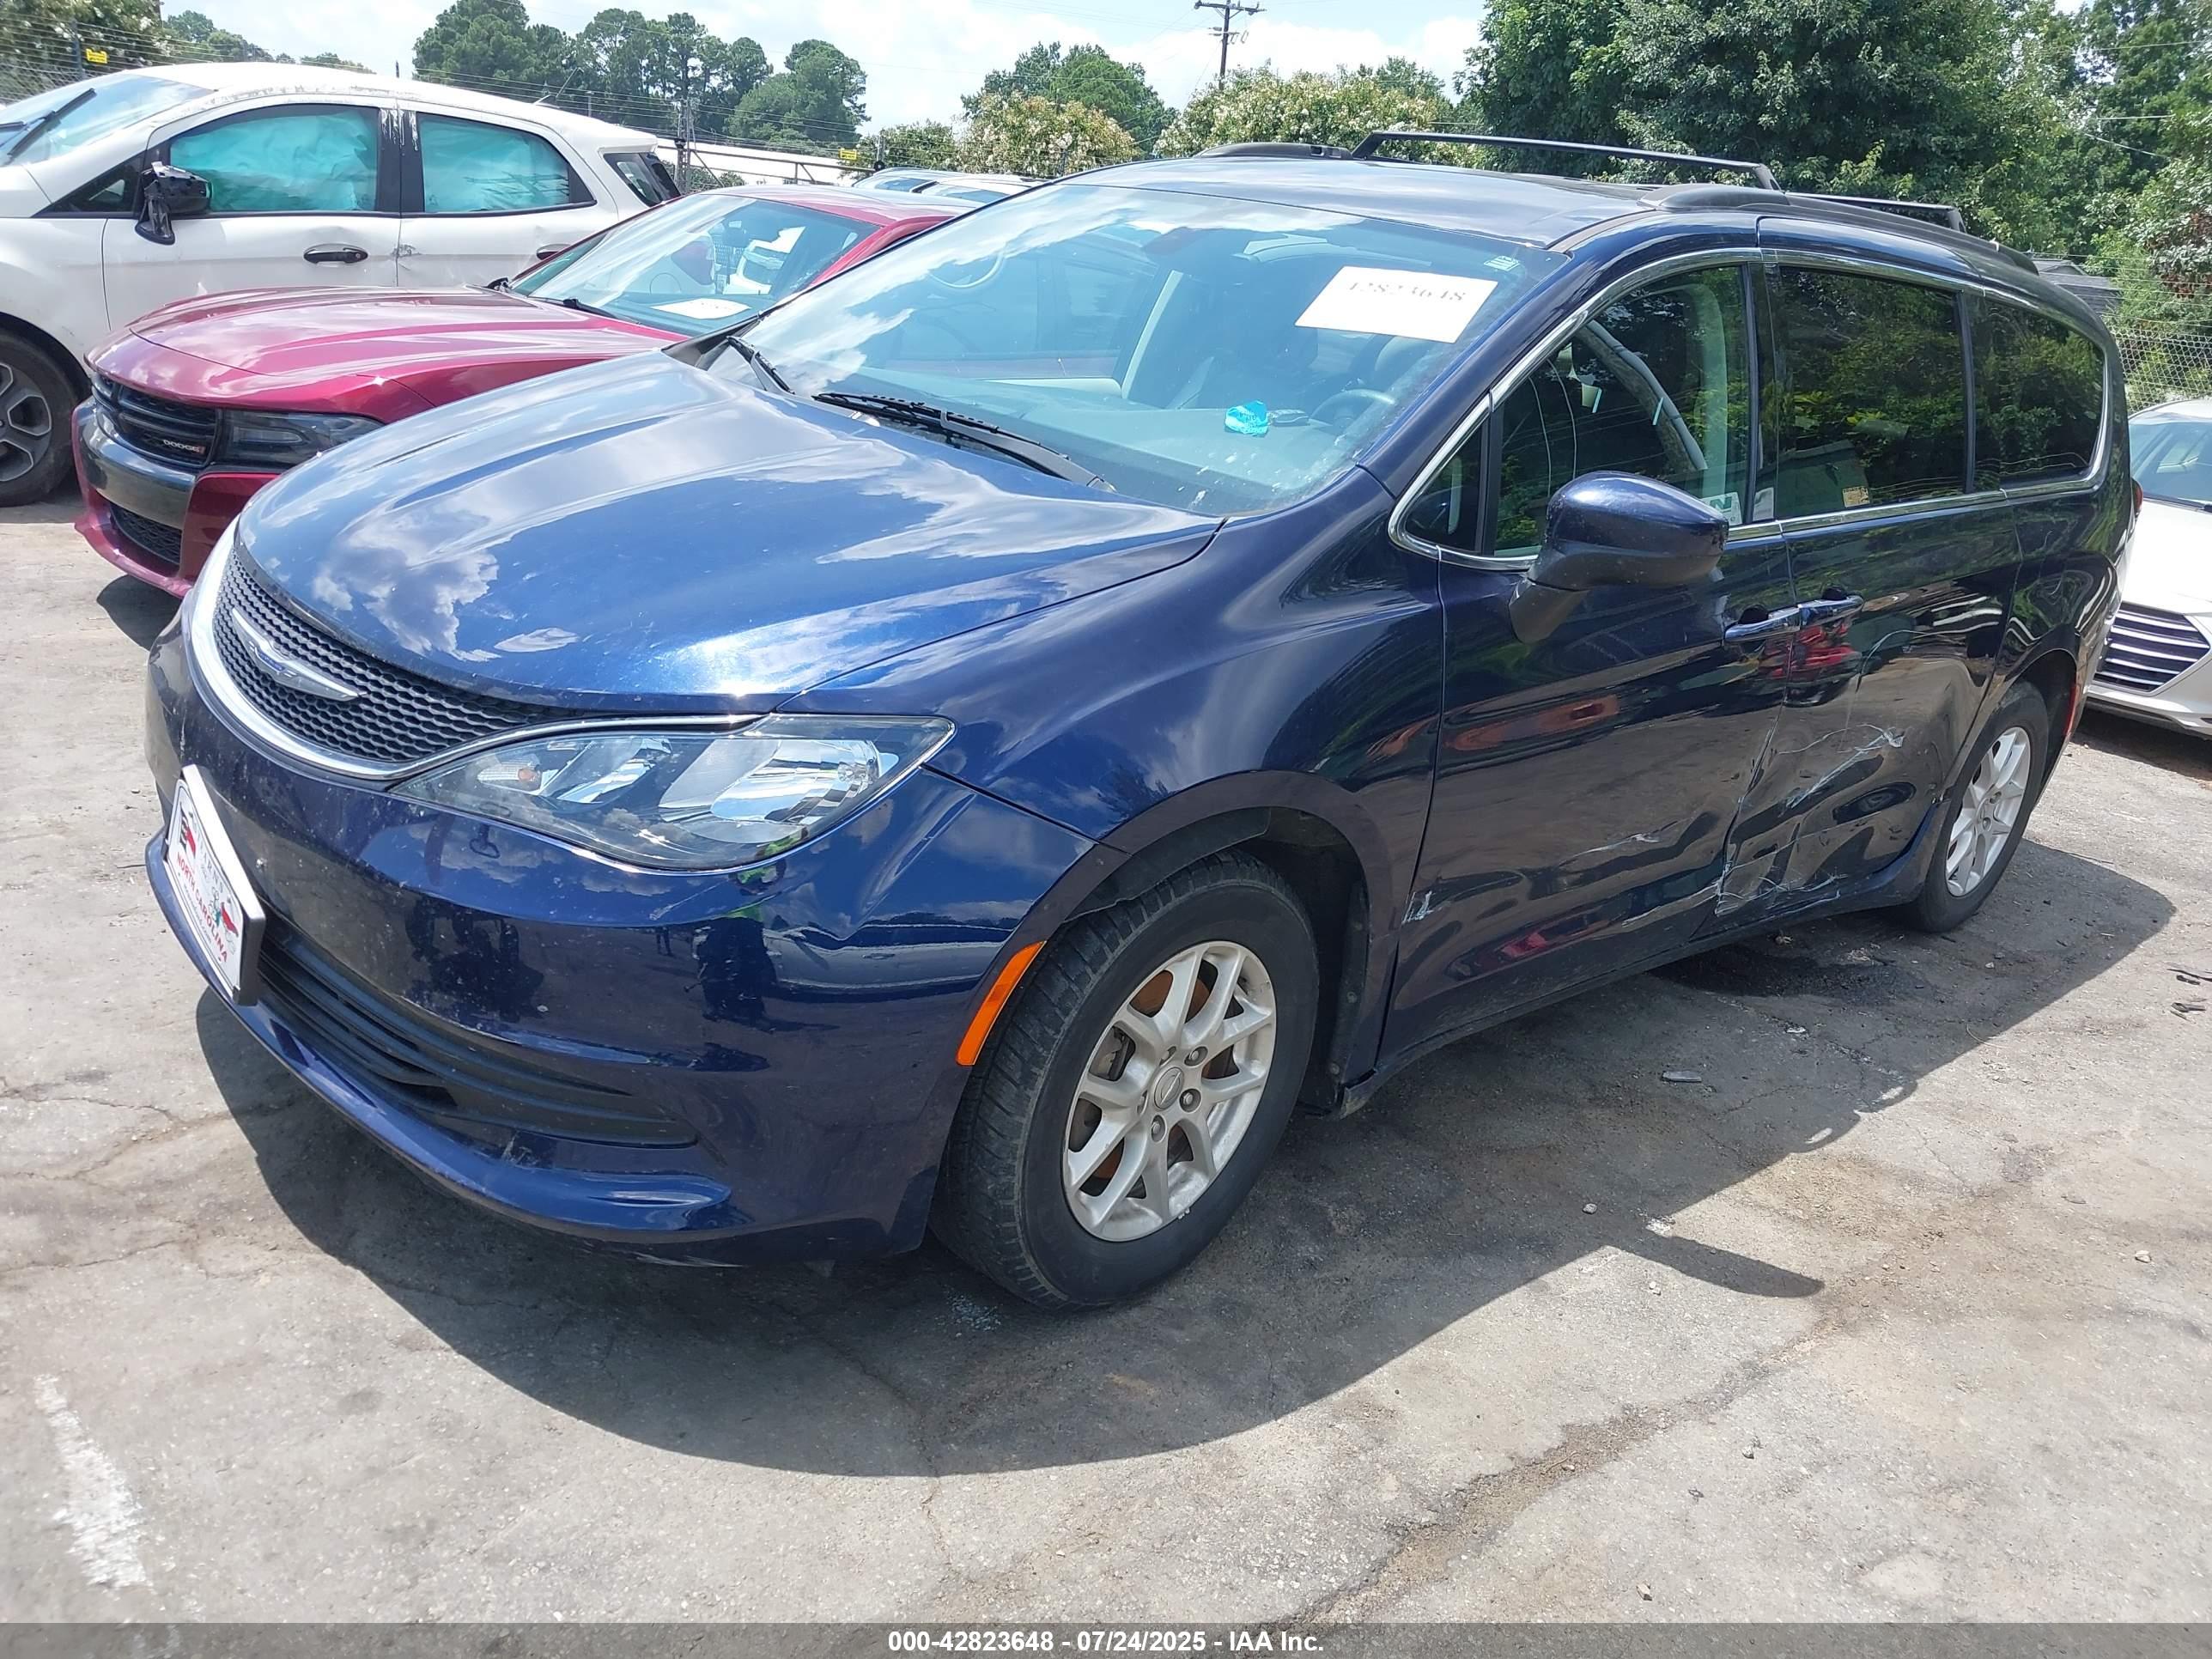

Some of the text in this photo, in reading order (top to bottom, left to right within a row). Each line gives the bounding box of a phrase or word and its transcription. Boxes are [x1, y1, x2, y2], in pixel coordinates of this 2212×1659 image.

[163, 439, 200, 453] DODGE
[177, 851, 197, 891] NORTH
[194, 888, 228, 963] CAROLINA
